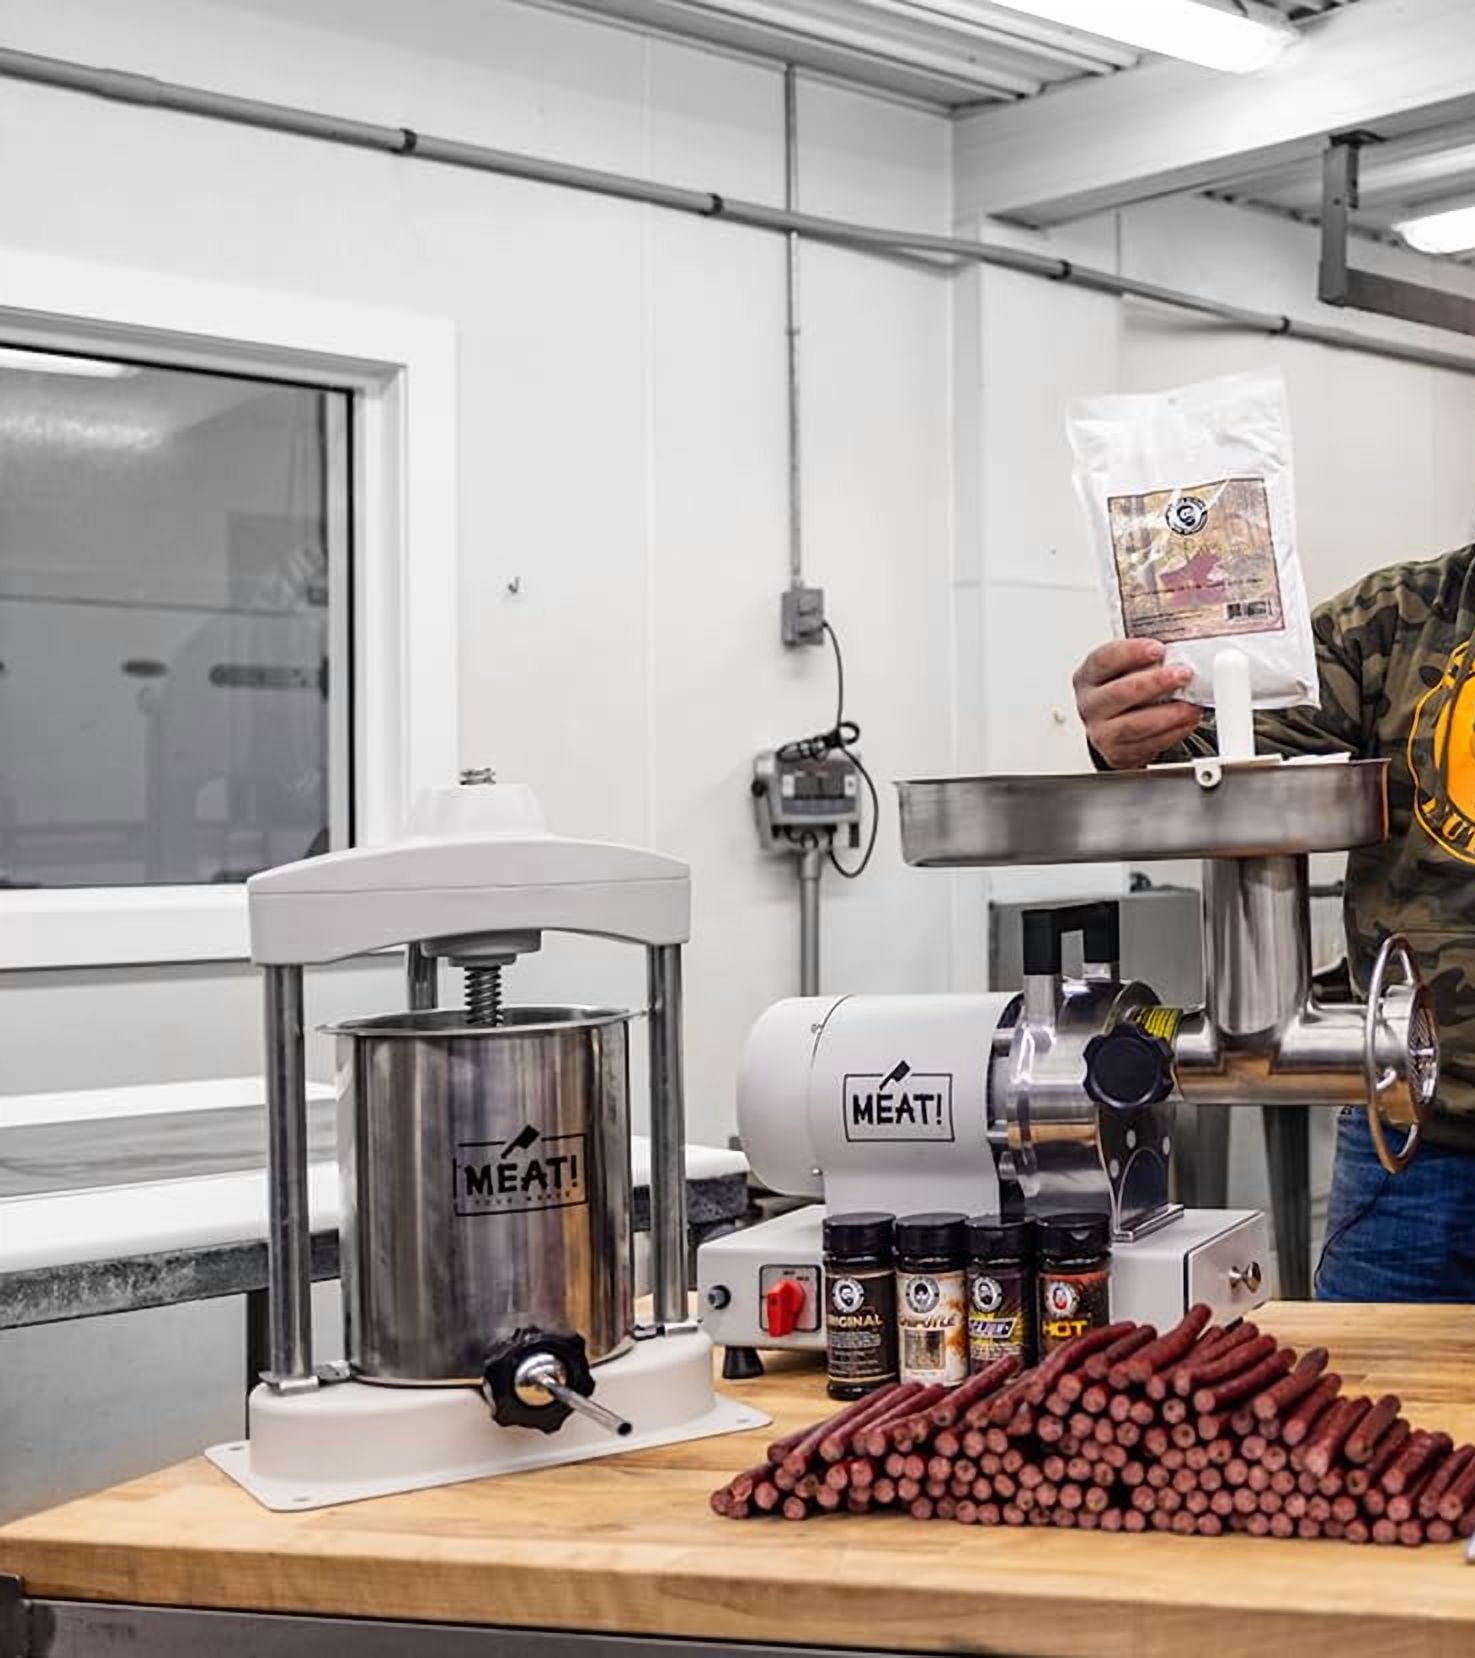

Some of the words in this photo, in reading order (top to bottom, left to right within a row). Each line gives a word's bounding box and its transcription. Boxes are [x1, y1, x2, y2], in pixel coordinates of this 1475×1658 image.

[853, 1091, 942, 1126] MEAT!
[464, 1154, 577, 1196] MEAT!
[1041, 1319, 1089, 1338] HOT
